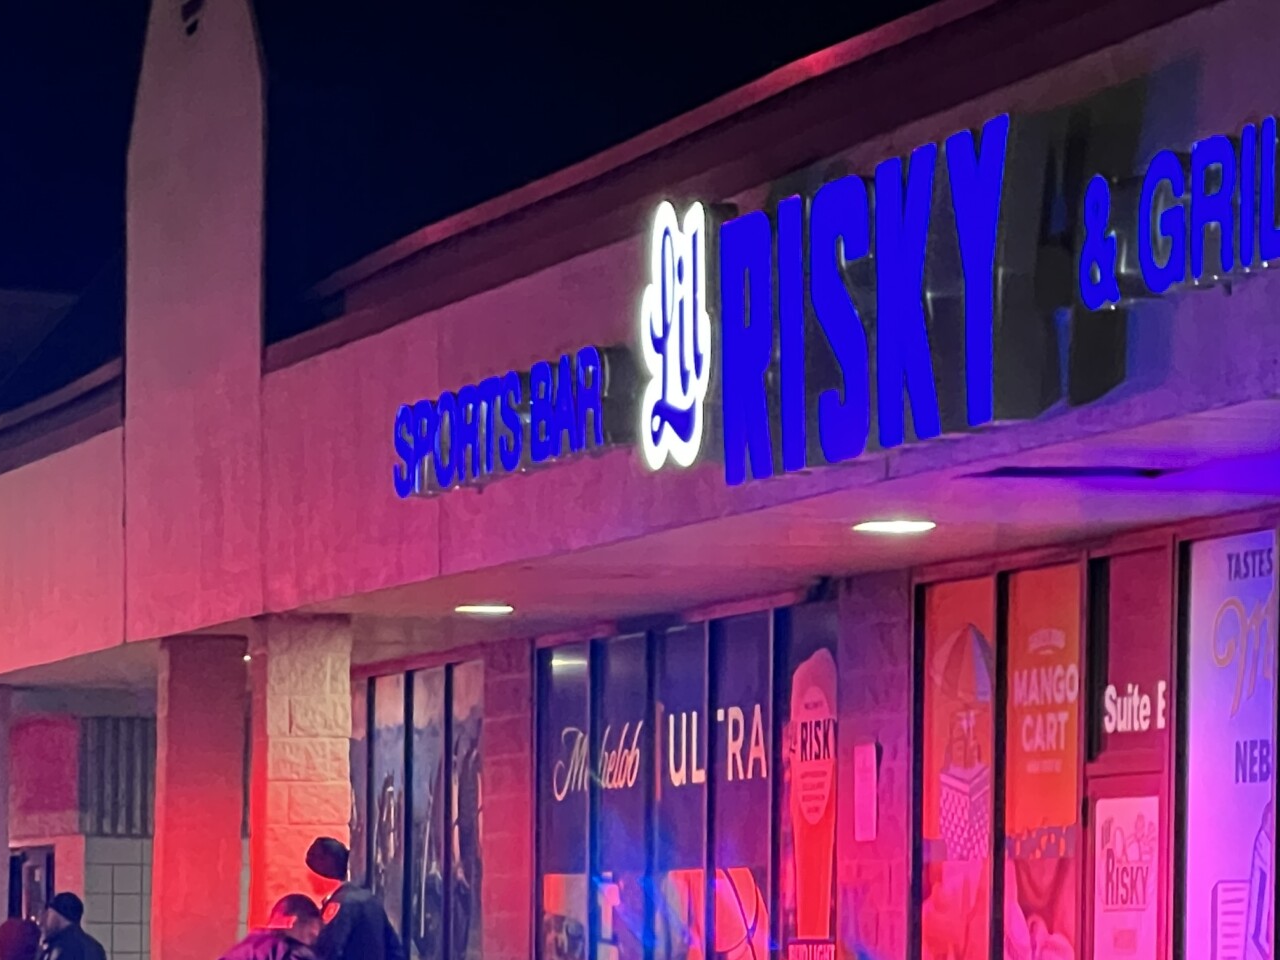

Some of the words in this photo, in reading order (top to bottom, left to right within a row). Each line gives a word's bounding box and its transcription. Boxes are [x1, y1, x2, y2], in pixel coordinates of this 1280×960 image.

[1079, 174, 1119, 310] &
[720, 112, 1009, 486] RISKY
[393, 371, 522, 498] SPORTS
[530, 345, 603, 463] BAR
[1227, 547, 1273, 582] TASTES
[1014, 663, 1079, 707] MANGO
[1104, 684, 1150, 733] Suite
[669, 704, 767, 787] ULRA
[1022, 711, 1069, 752] CART
[1105, 848, 1149, 905] RISKY
